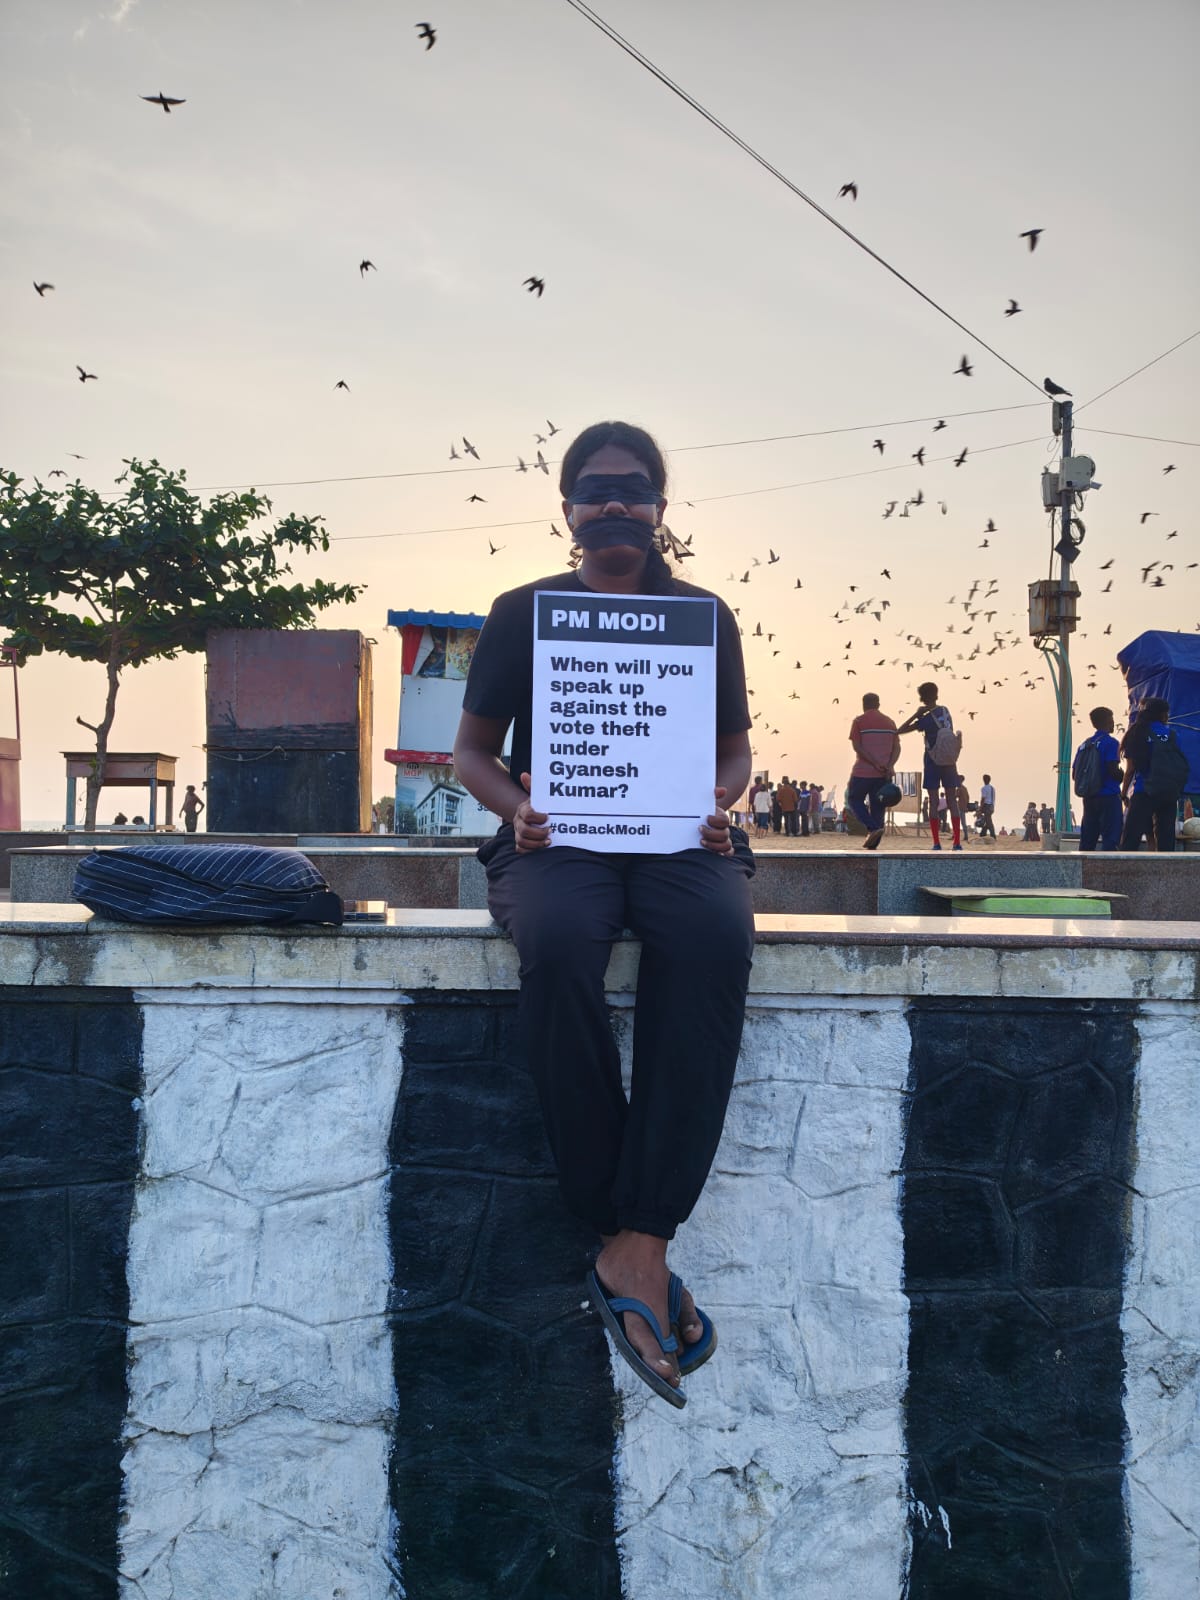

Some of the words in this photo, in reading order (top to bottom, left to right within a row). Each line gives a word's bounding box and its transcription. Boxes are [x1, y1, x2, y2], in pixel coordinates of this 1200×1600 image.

[552, 609, 589, 628] PM
[599, 611, 665, 632] MODI
[551, 657, 608, 673] When
[615, 658, 650, 674] will
[657, 662, 693, 678] you
[551, 679, 612, 696] speak
[619, 683, 644, 698] up
[550, 699, 627, 717] against
[634, 702, 666, 716] the
[550, 721, 595, 735] vote
[602, 720, 650, 736] theft
[550, 741, 609, 756] under
[550, 761, 638, 779] Gyanesh
[549, 782, 628, 798] Kumar?
